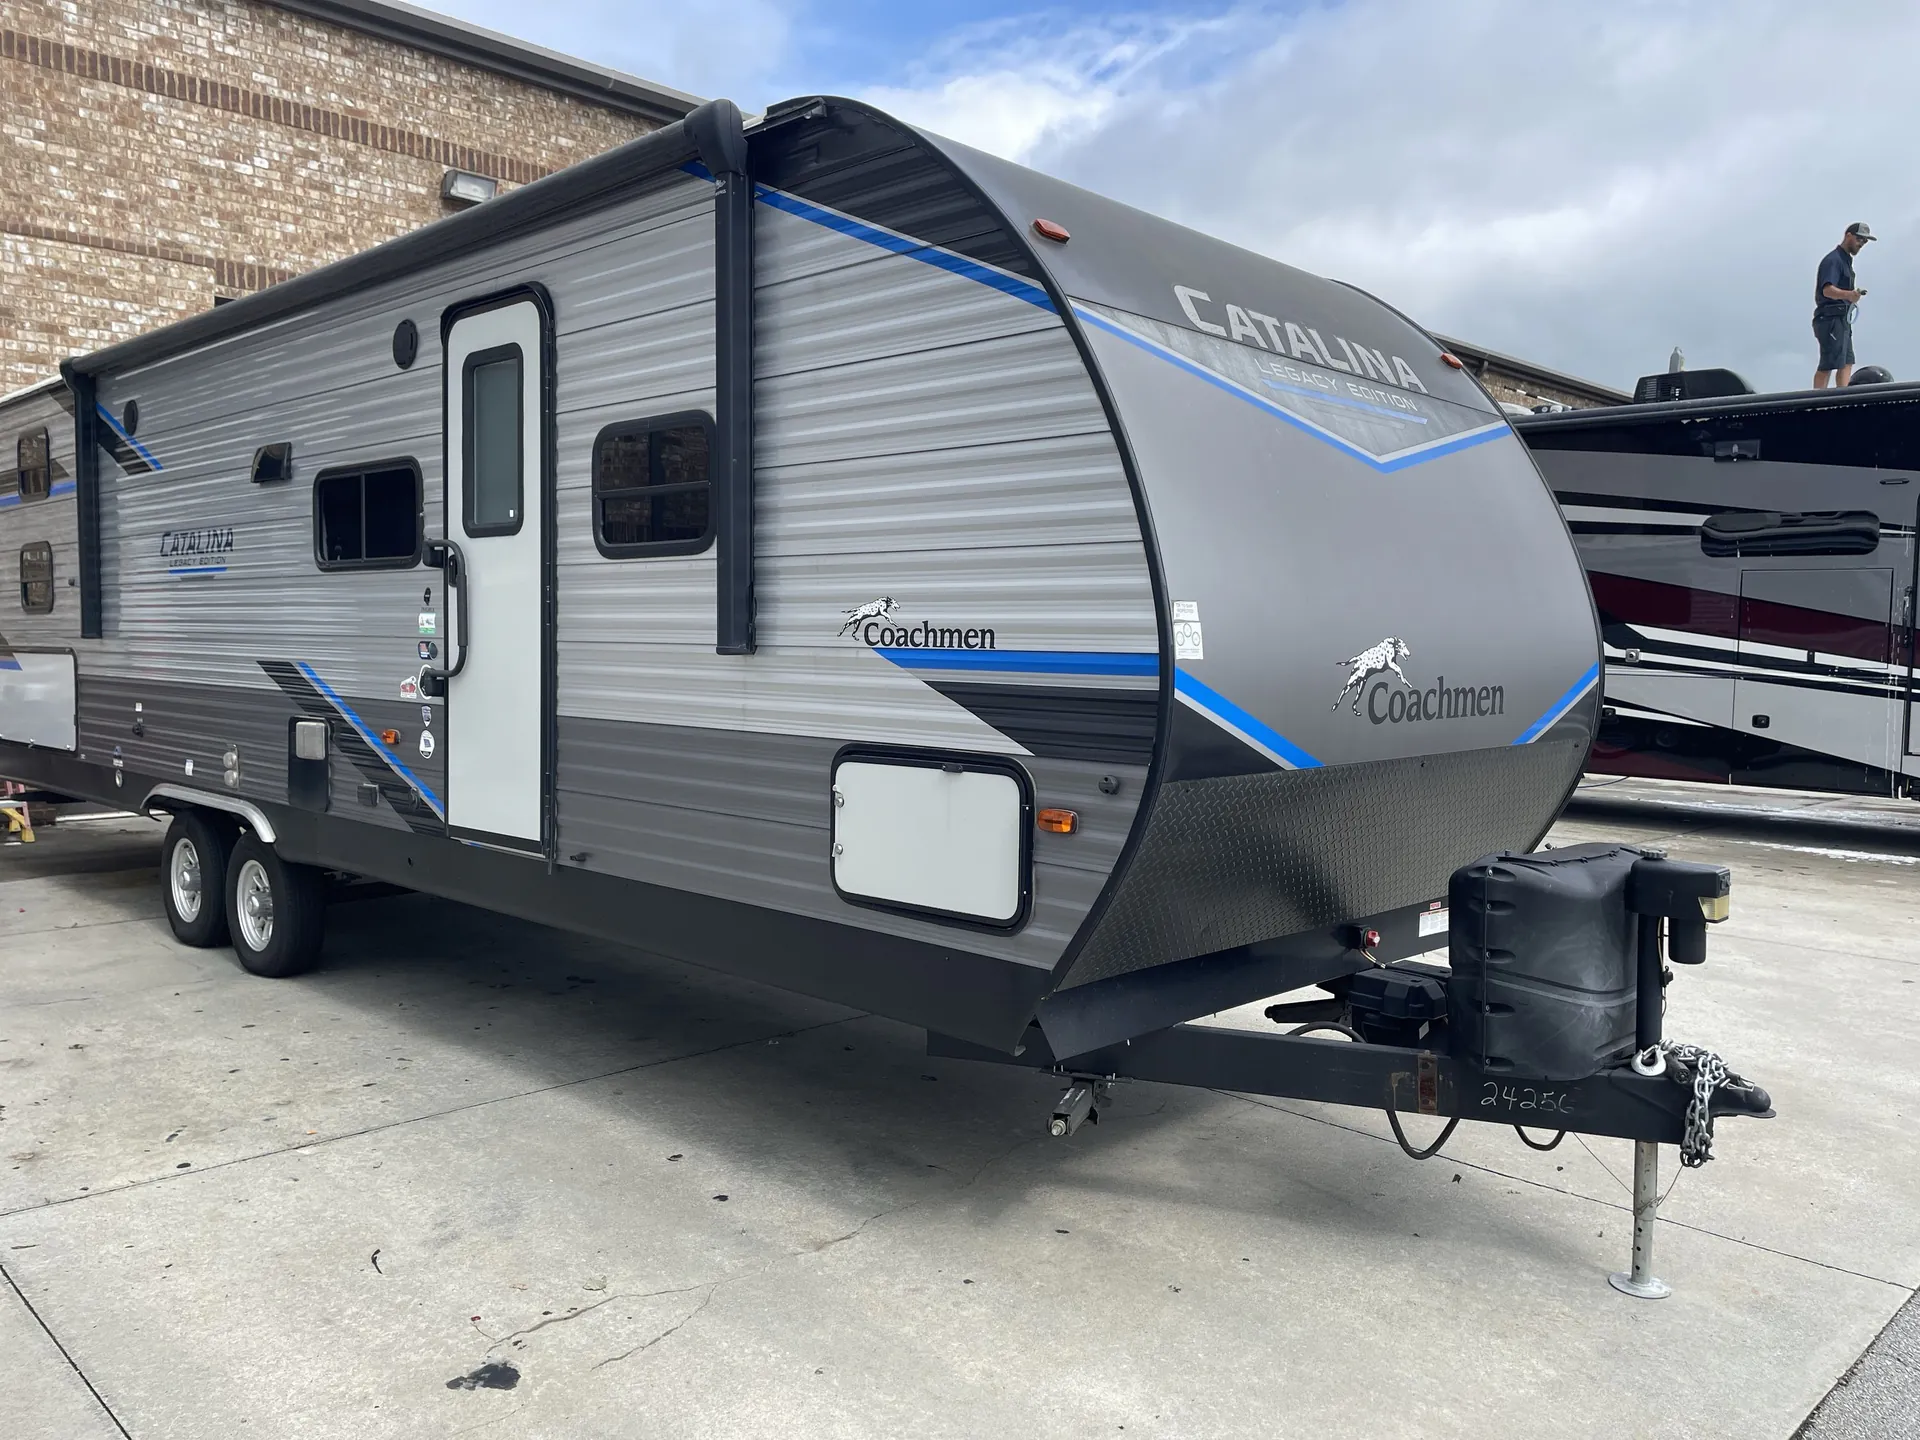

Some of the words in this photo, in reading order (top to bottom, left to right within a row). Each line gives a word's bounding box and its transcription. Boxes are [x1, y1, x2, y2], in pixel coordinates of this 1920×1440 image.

[1173, 284, 1429, 394] CATALINA
[1254, 358, 1339, 391] LEGACY
[1346, 382, 1418, 411] EDITION
[160, 528, 233, 556] CATALINA
[170, 558, 197, 567] LEGACY
[200, 556, 226, 565] EDITION
[863, 620, 996, 649] Coachmen
[1367, 675, 1505, 725] Coachmen
[1480, 1081, 1575, 1114] 24256
